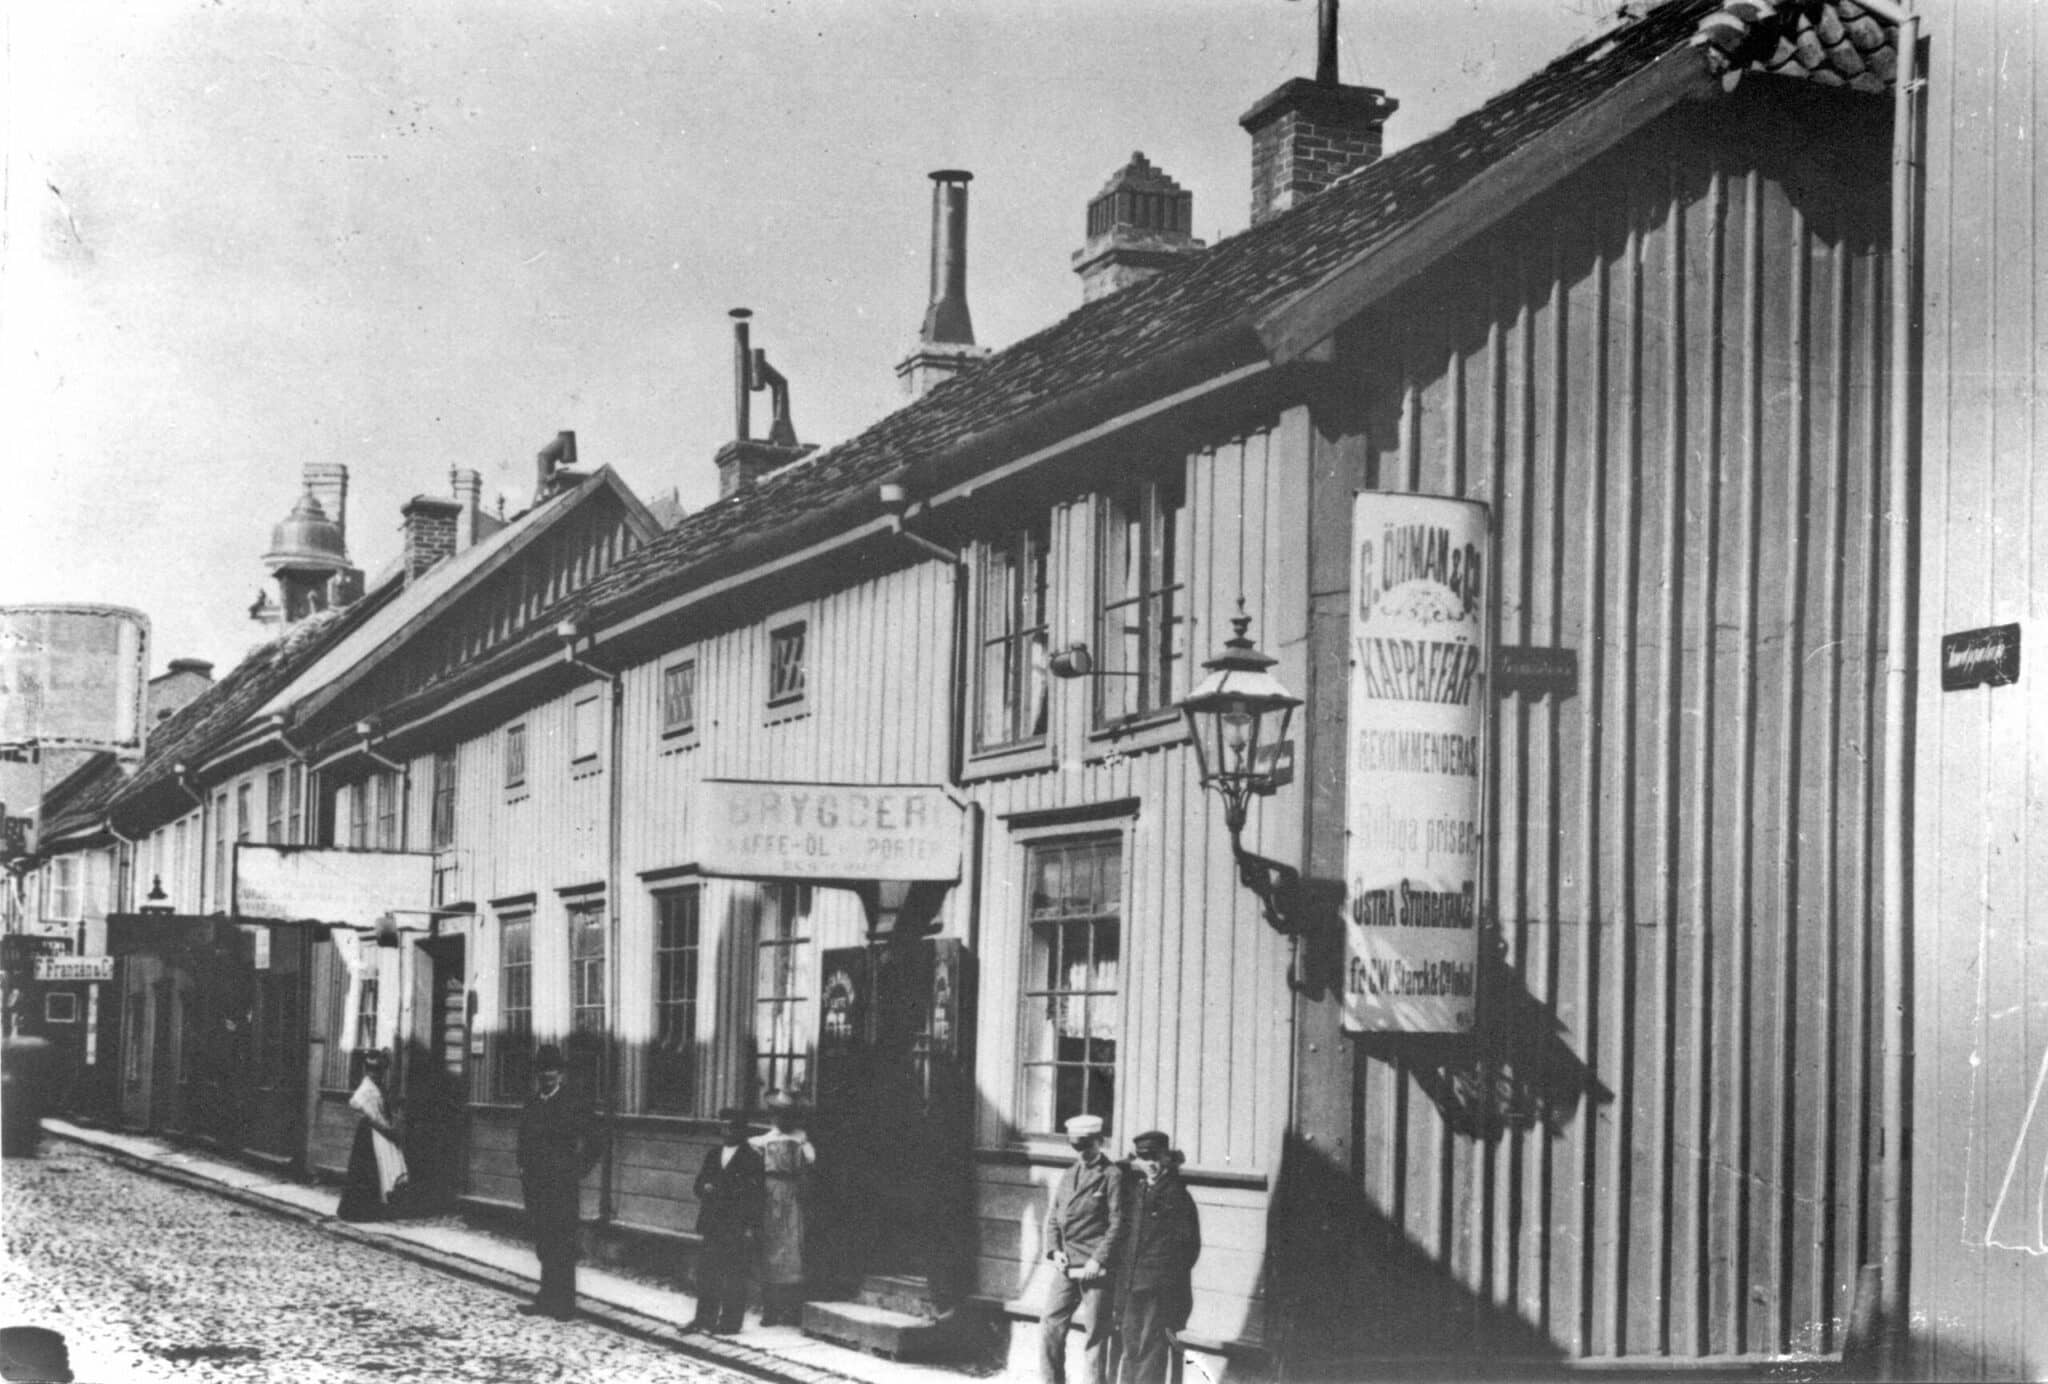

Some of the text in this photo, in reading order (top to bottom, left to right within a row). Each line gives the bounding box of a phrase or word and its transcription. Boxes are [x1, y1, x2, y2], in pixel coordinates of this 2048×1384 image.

[1382, 522, 1450, 592] ÖHMAN
[1449, 548, 1463, 598] &
[1356, 635, 1481, 706] KAPPAFFÄR
[1359, 729, 1478, 777] REKOMMENDERAS
